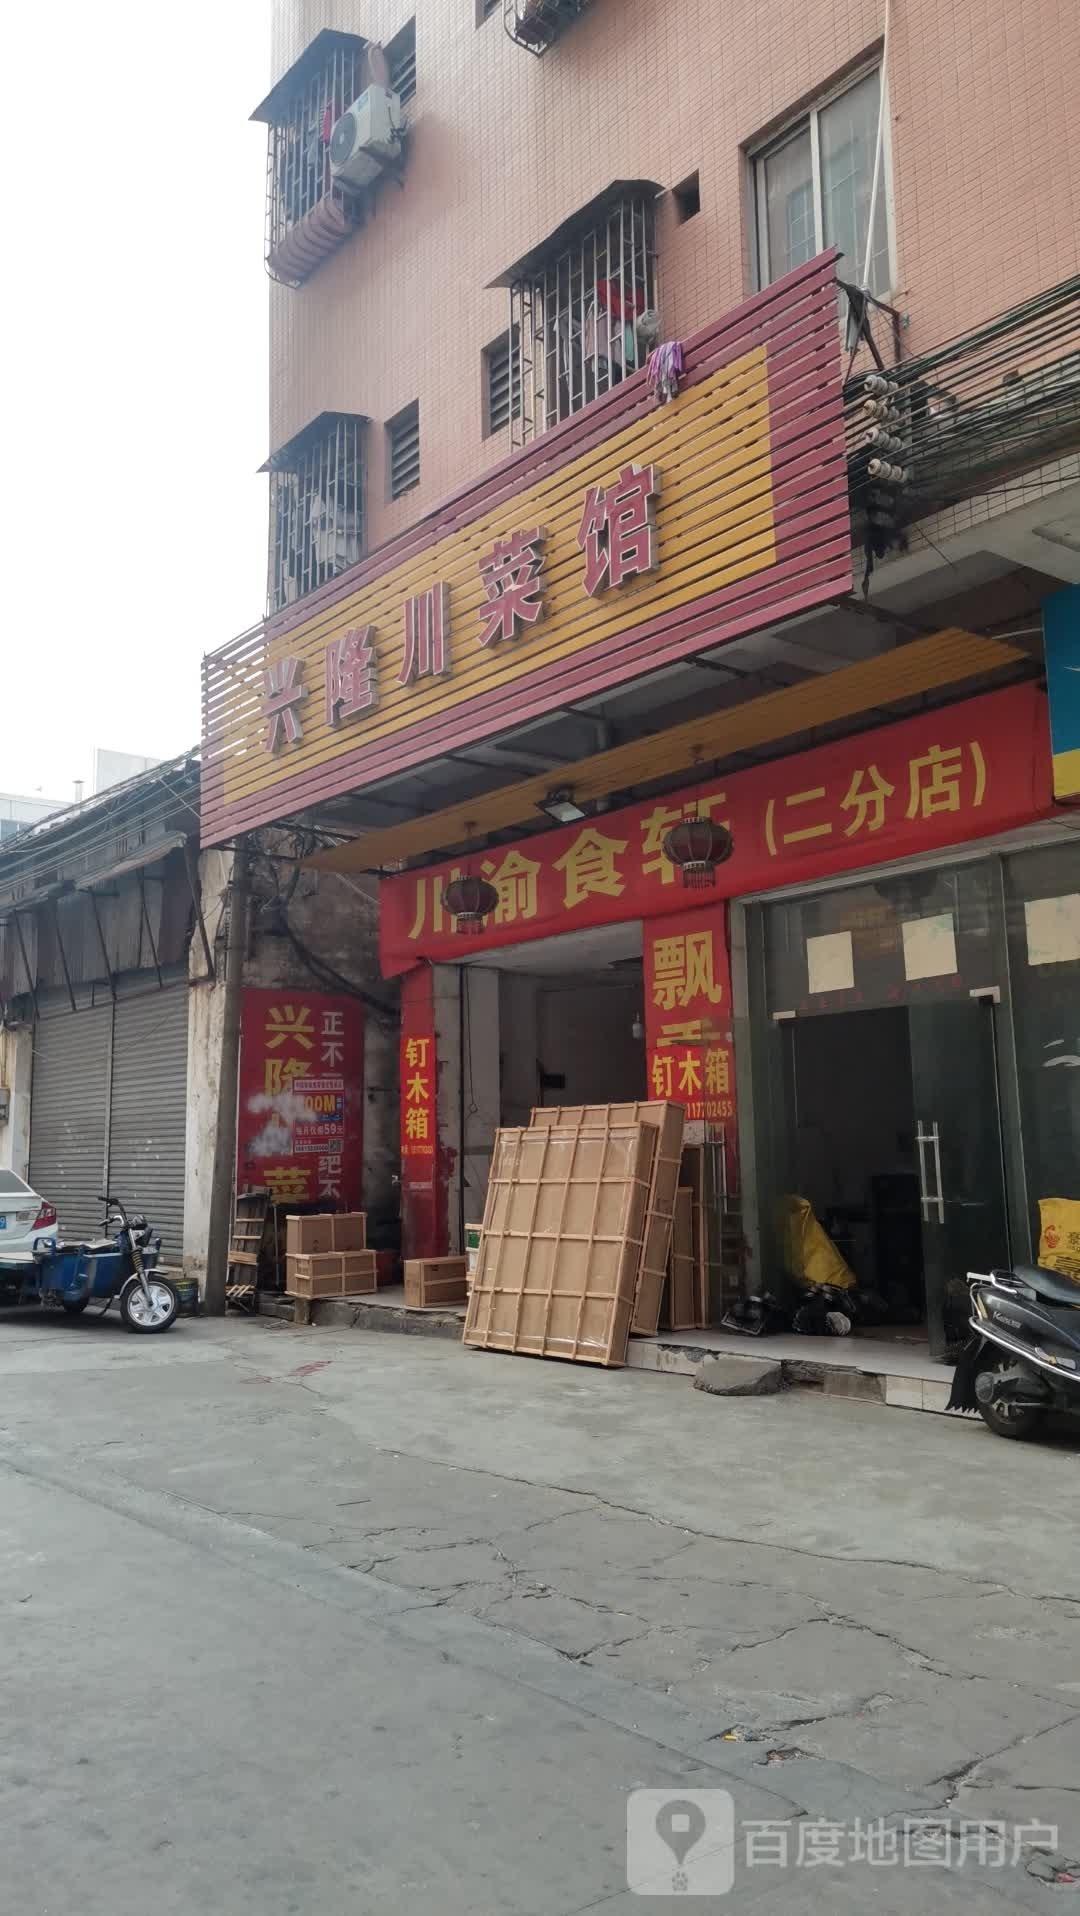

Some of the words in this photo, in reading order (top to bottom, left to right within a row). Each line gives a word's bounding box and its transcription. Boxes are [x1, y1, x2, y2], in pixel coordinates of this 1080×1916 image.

[260, 464, 661, 753] 兴隆川菜馆
[264, 1005, 315, 1206] 兴隆菜
[405, 1037, 430, 1140] 钉木箱
[652, 1048, 729, 1097] 钉木箱
